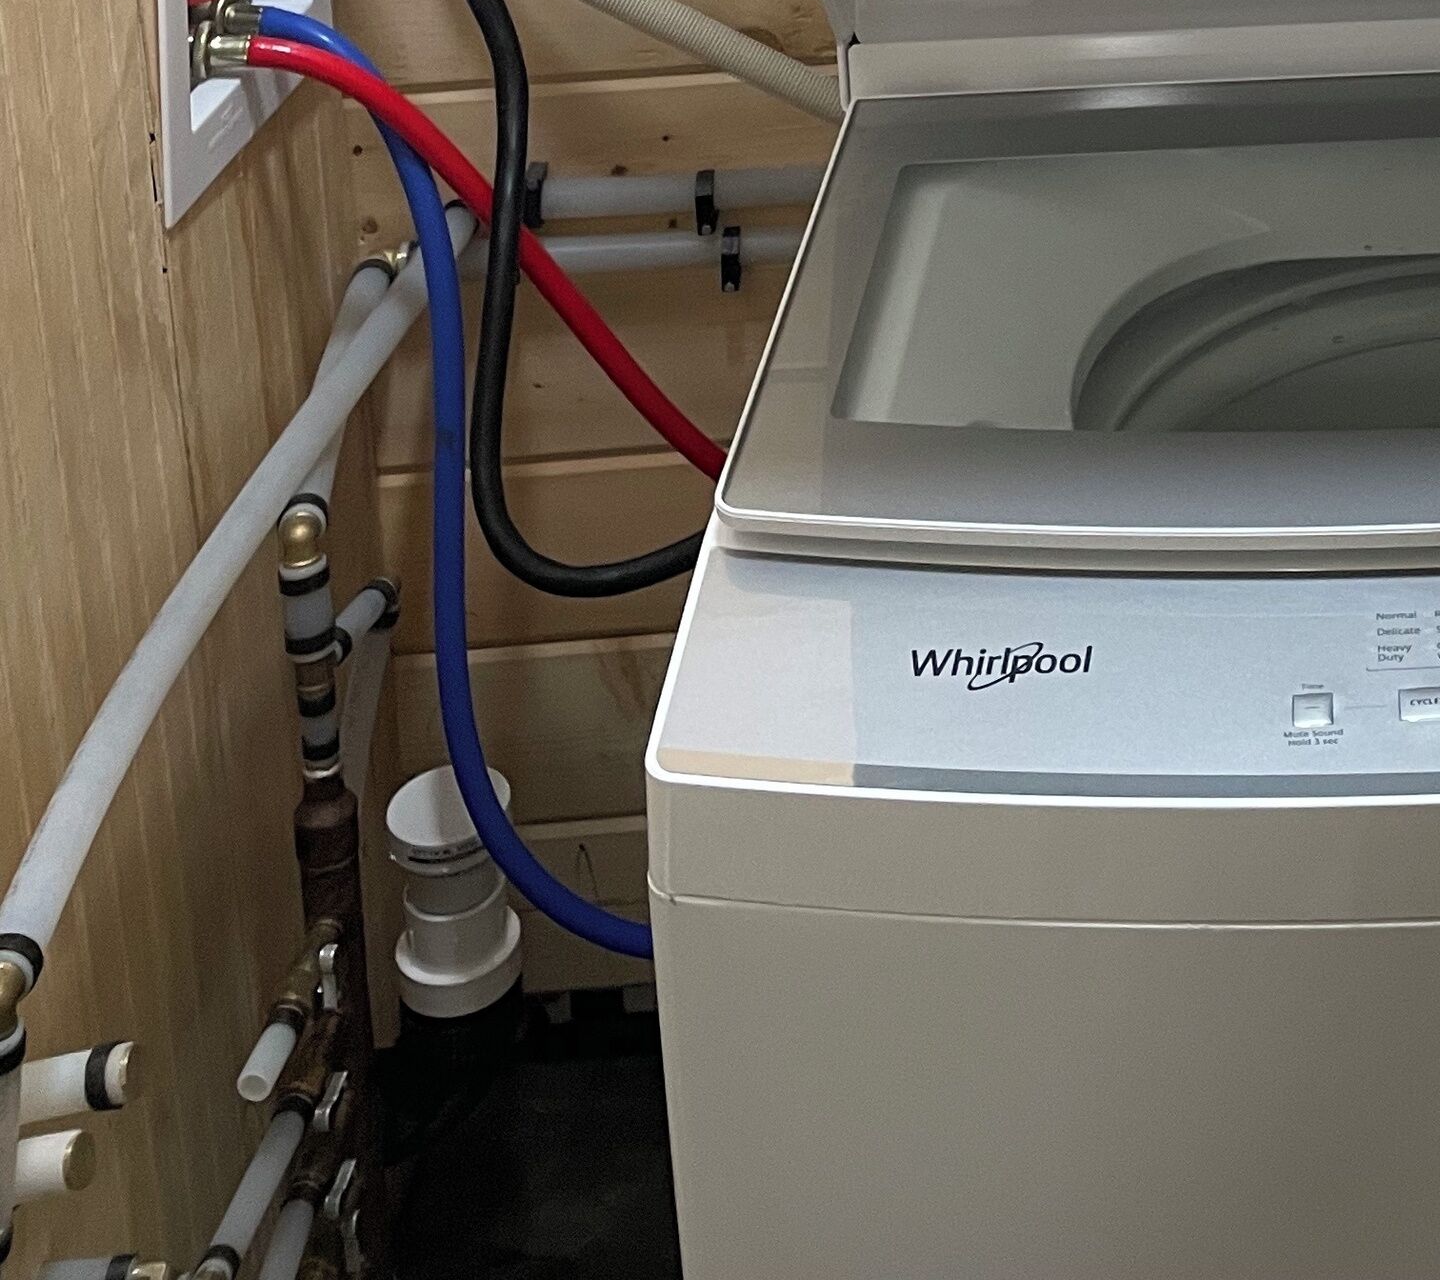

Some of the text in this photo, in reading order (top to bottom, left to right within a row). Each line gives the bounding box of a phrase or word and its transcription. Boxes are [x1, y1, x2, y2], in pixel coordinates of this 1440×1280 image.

[1376, 611, 1416, 621] Normal
[1377, 627, 1421, 636] Delicate
[1378, 644, 1412, 653] Heavy
[1378, 654, 1404, 663] Duty
[911, 642, 1093, 691] Whirlpool
